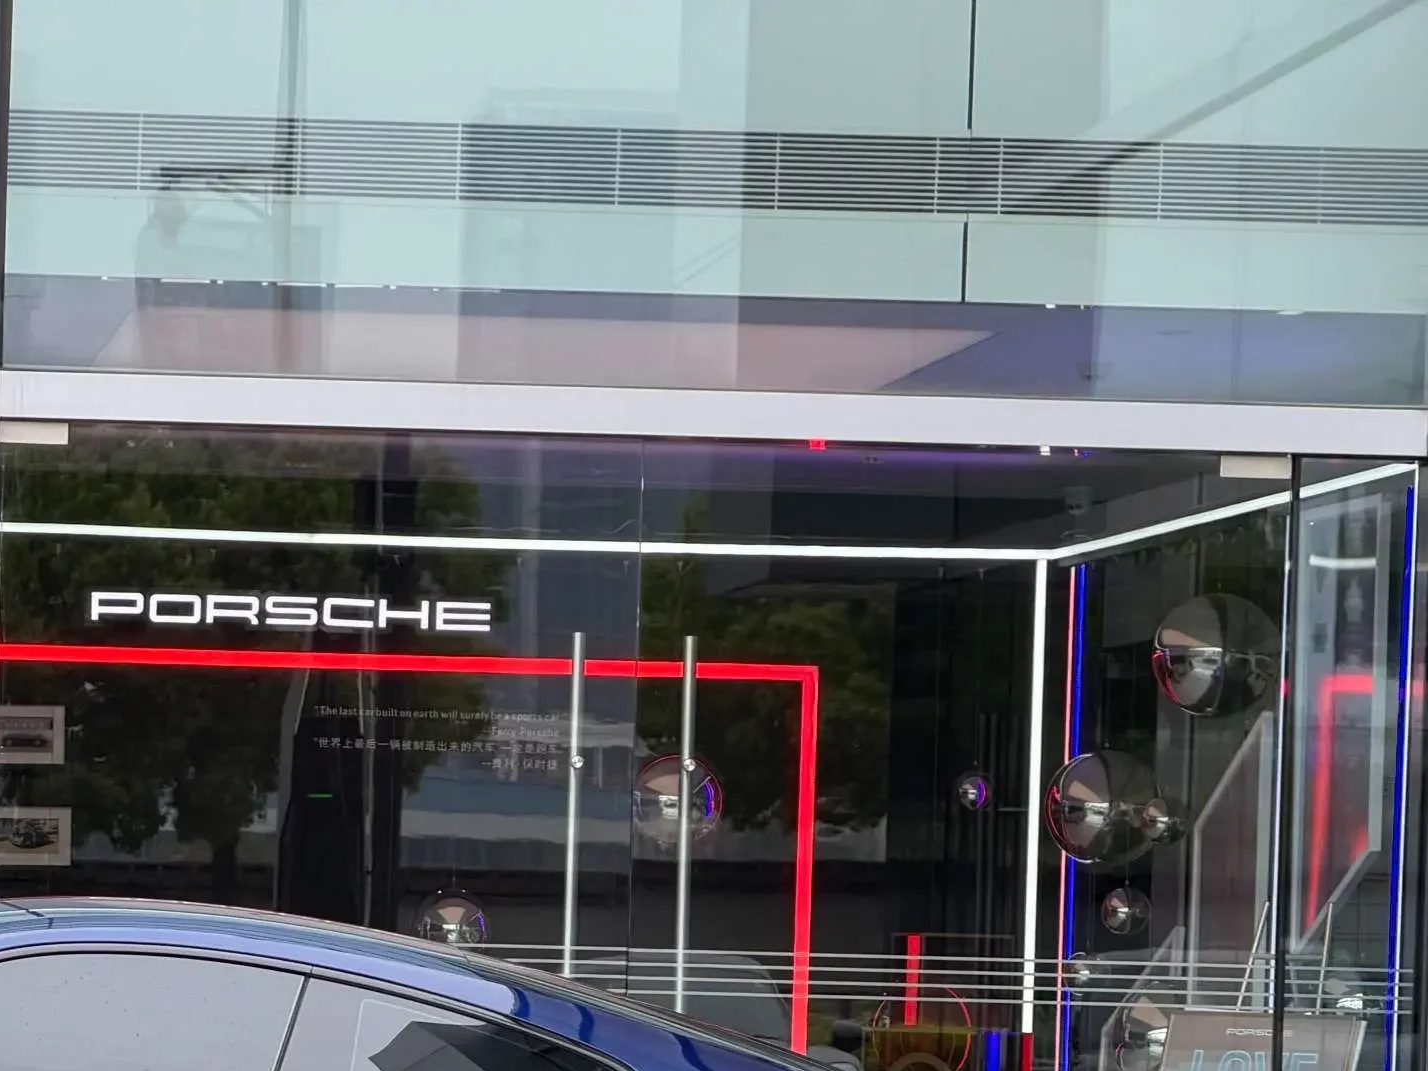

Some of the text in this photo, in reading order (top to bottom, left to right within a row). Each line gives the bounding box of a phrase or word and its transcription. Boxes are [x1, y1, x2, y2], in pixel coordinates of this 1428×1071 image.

[90, 591, 491, 632] PORSCHE
[339, 707, 357, 716] last
[375, 707, 398, 718] built
[400, 709, 412, 718] on
[413, 709, 439, 719] earth
[440, 709, 458, 720] will
[459, 710, 489, 722] surely
[1226, 1028, 1293, 1037] PORSCE
